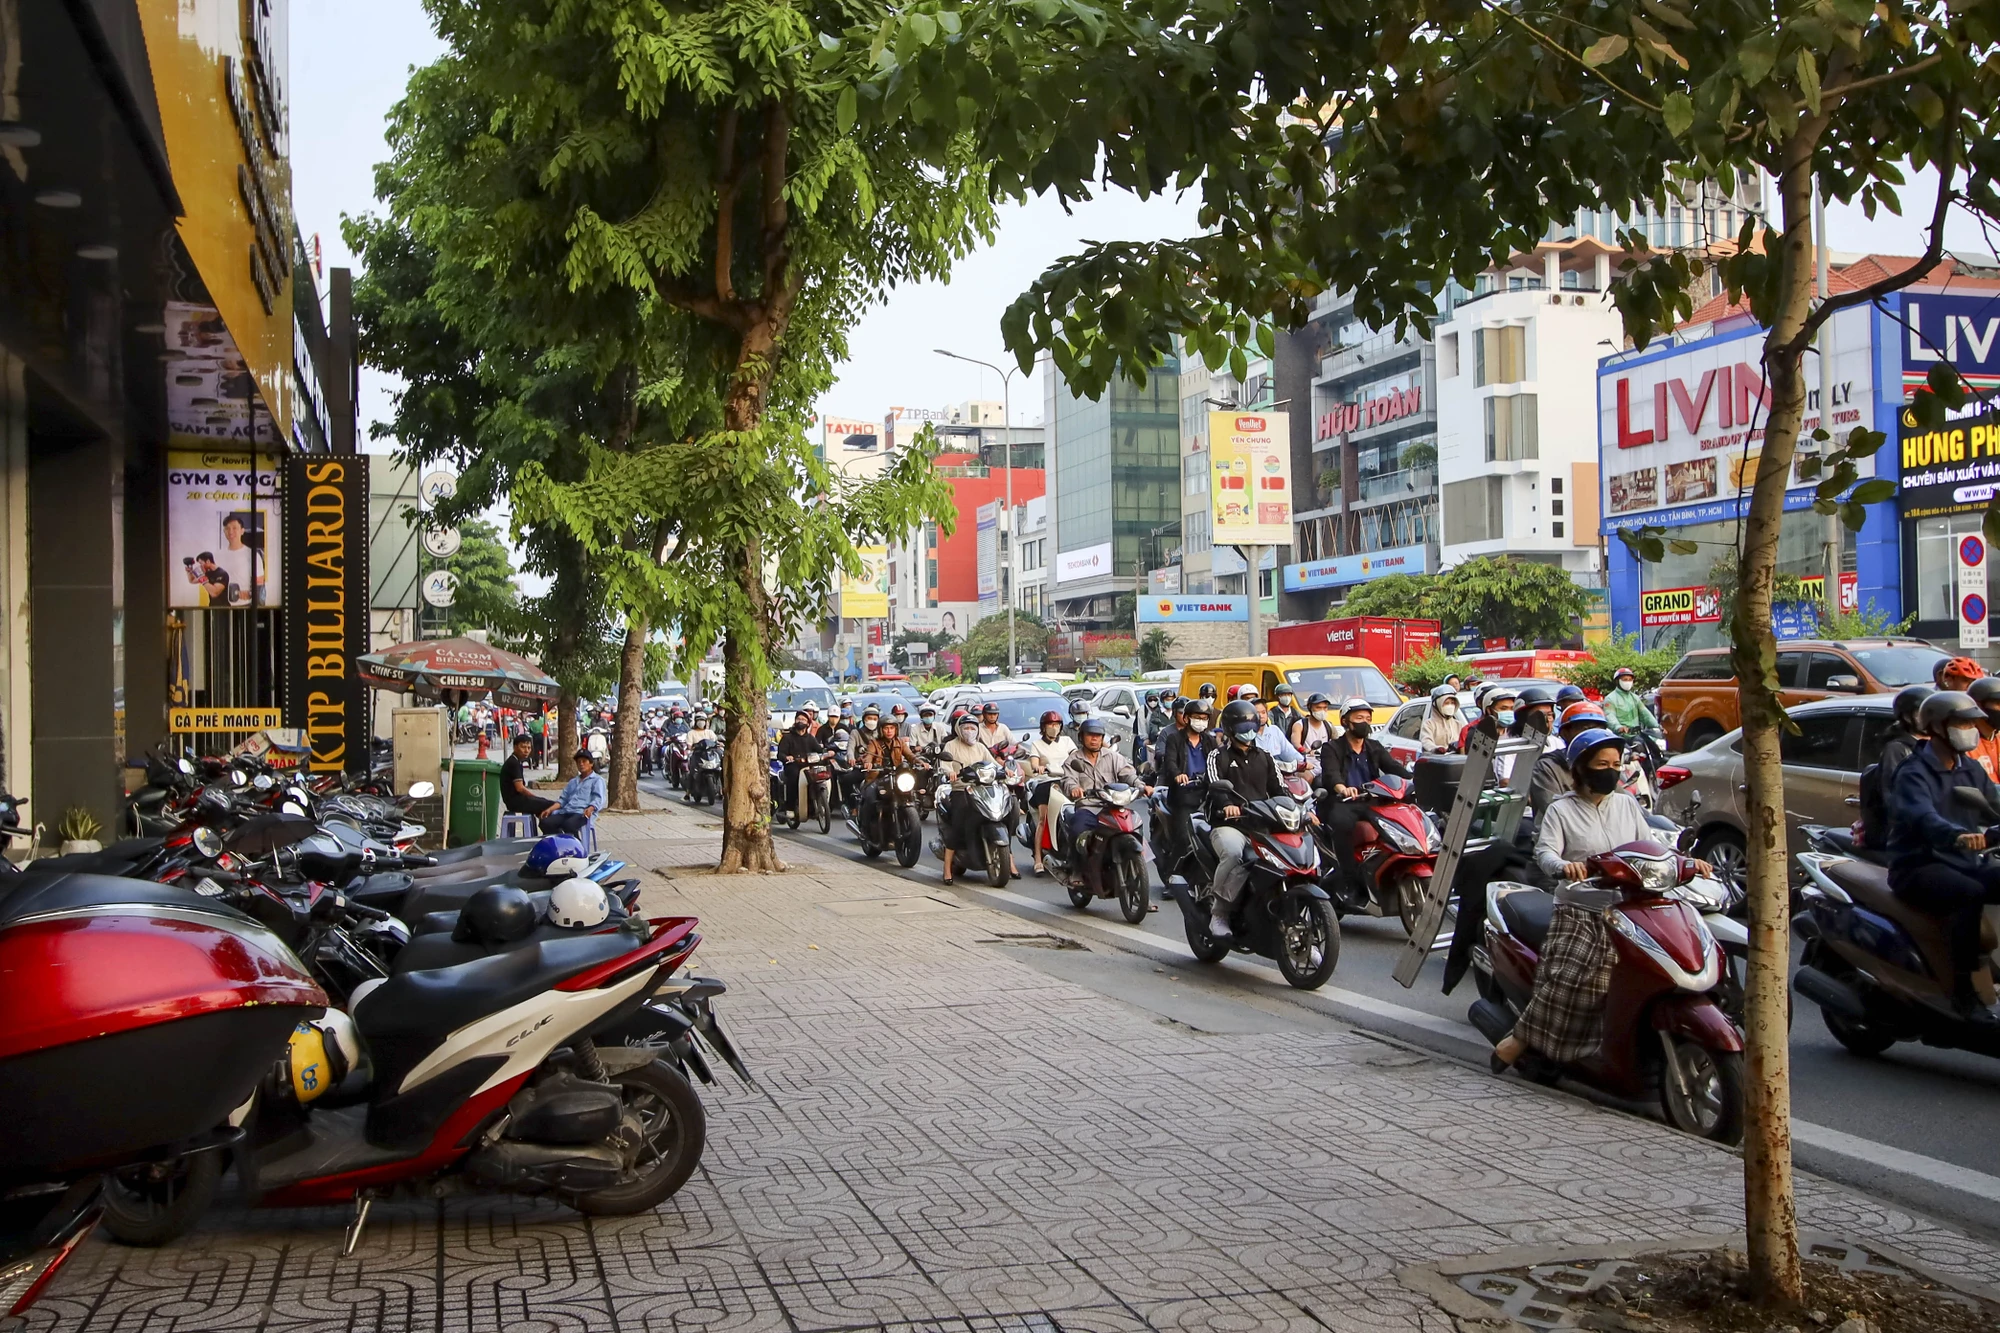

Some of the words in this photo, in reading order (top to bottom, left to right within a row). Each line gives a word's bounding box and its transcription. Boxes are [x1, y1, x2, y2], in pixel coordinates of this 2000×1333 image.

[1807, 381, 1853, 411] ITLY
[1363, 386, 1422, 429] TOÀN
[1617, 363, 1773, 449] LIVIN
[906, 408, 950, 420] TPBank
[1903, 430, 1964, 468] HƯNG
[169, 472, 210, 485] GYM
[215, 474, 228, 486] &
[1902, 470, 1936, 488] CHUYÊN
[1956, 462, 1980, 482] XUẤT
[1371, 556, 1405, 569] VIETBANK
[306, 462, 345, 680] BILLIARDS
[1307, 566, 1337, 578] VIETBANK
[1176, 604, 1233, 612] VIETBANK
[1645, 593, 1691, 612] GRAND
[1326, 629, 1354, 642] viettel
[370, 664, 404, 679] CHIN-SU
[440, 675, 485, 687] CHIN-SU
[518, 682, 547, 695] CHIN-SU
[175, 712, 191, 728] CÀ
[196, 712, 219, 728] PHÊ
[223, 714, 259, 727] MANG
[264, 714, 276, 727] ĐI
[307, 692, 345, 772] KTP
